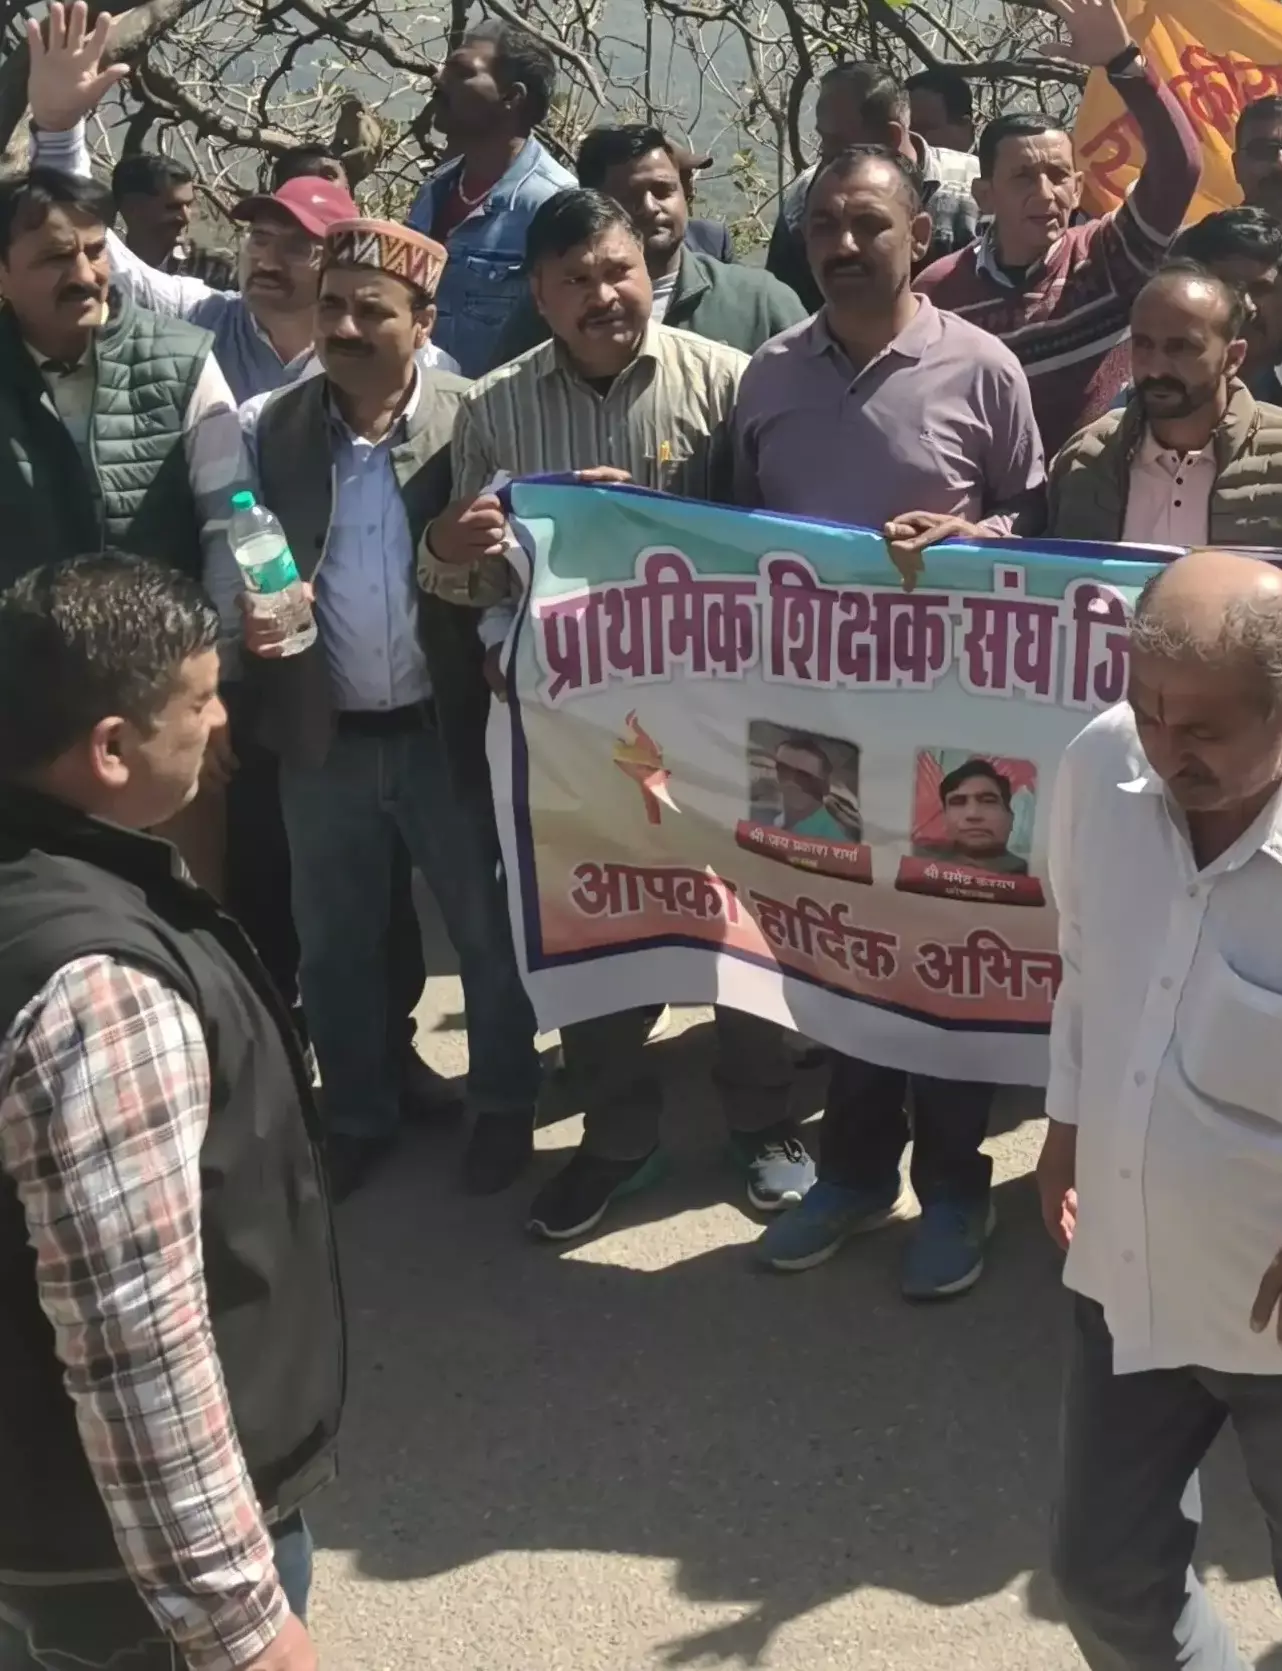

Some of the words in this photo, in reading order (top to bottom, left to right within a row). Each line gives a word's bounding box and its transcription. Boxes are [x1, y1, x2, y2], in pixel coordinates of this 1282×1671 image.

[541, 552, 757, 701] प्राथमिक
[769, 558, 949, 682] शिक्षक
[962, 571, 1060, 696] संघ
[571, 863, 739, 923] आपका
[749, 890, 898, 979] हार्दिक
